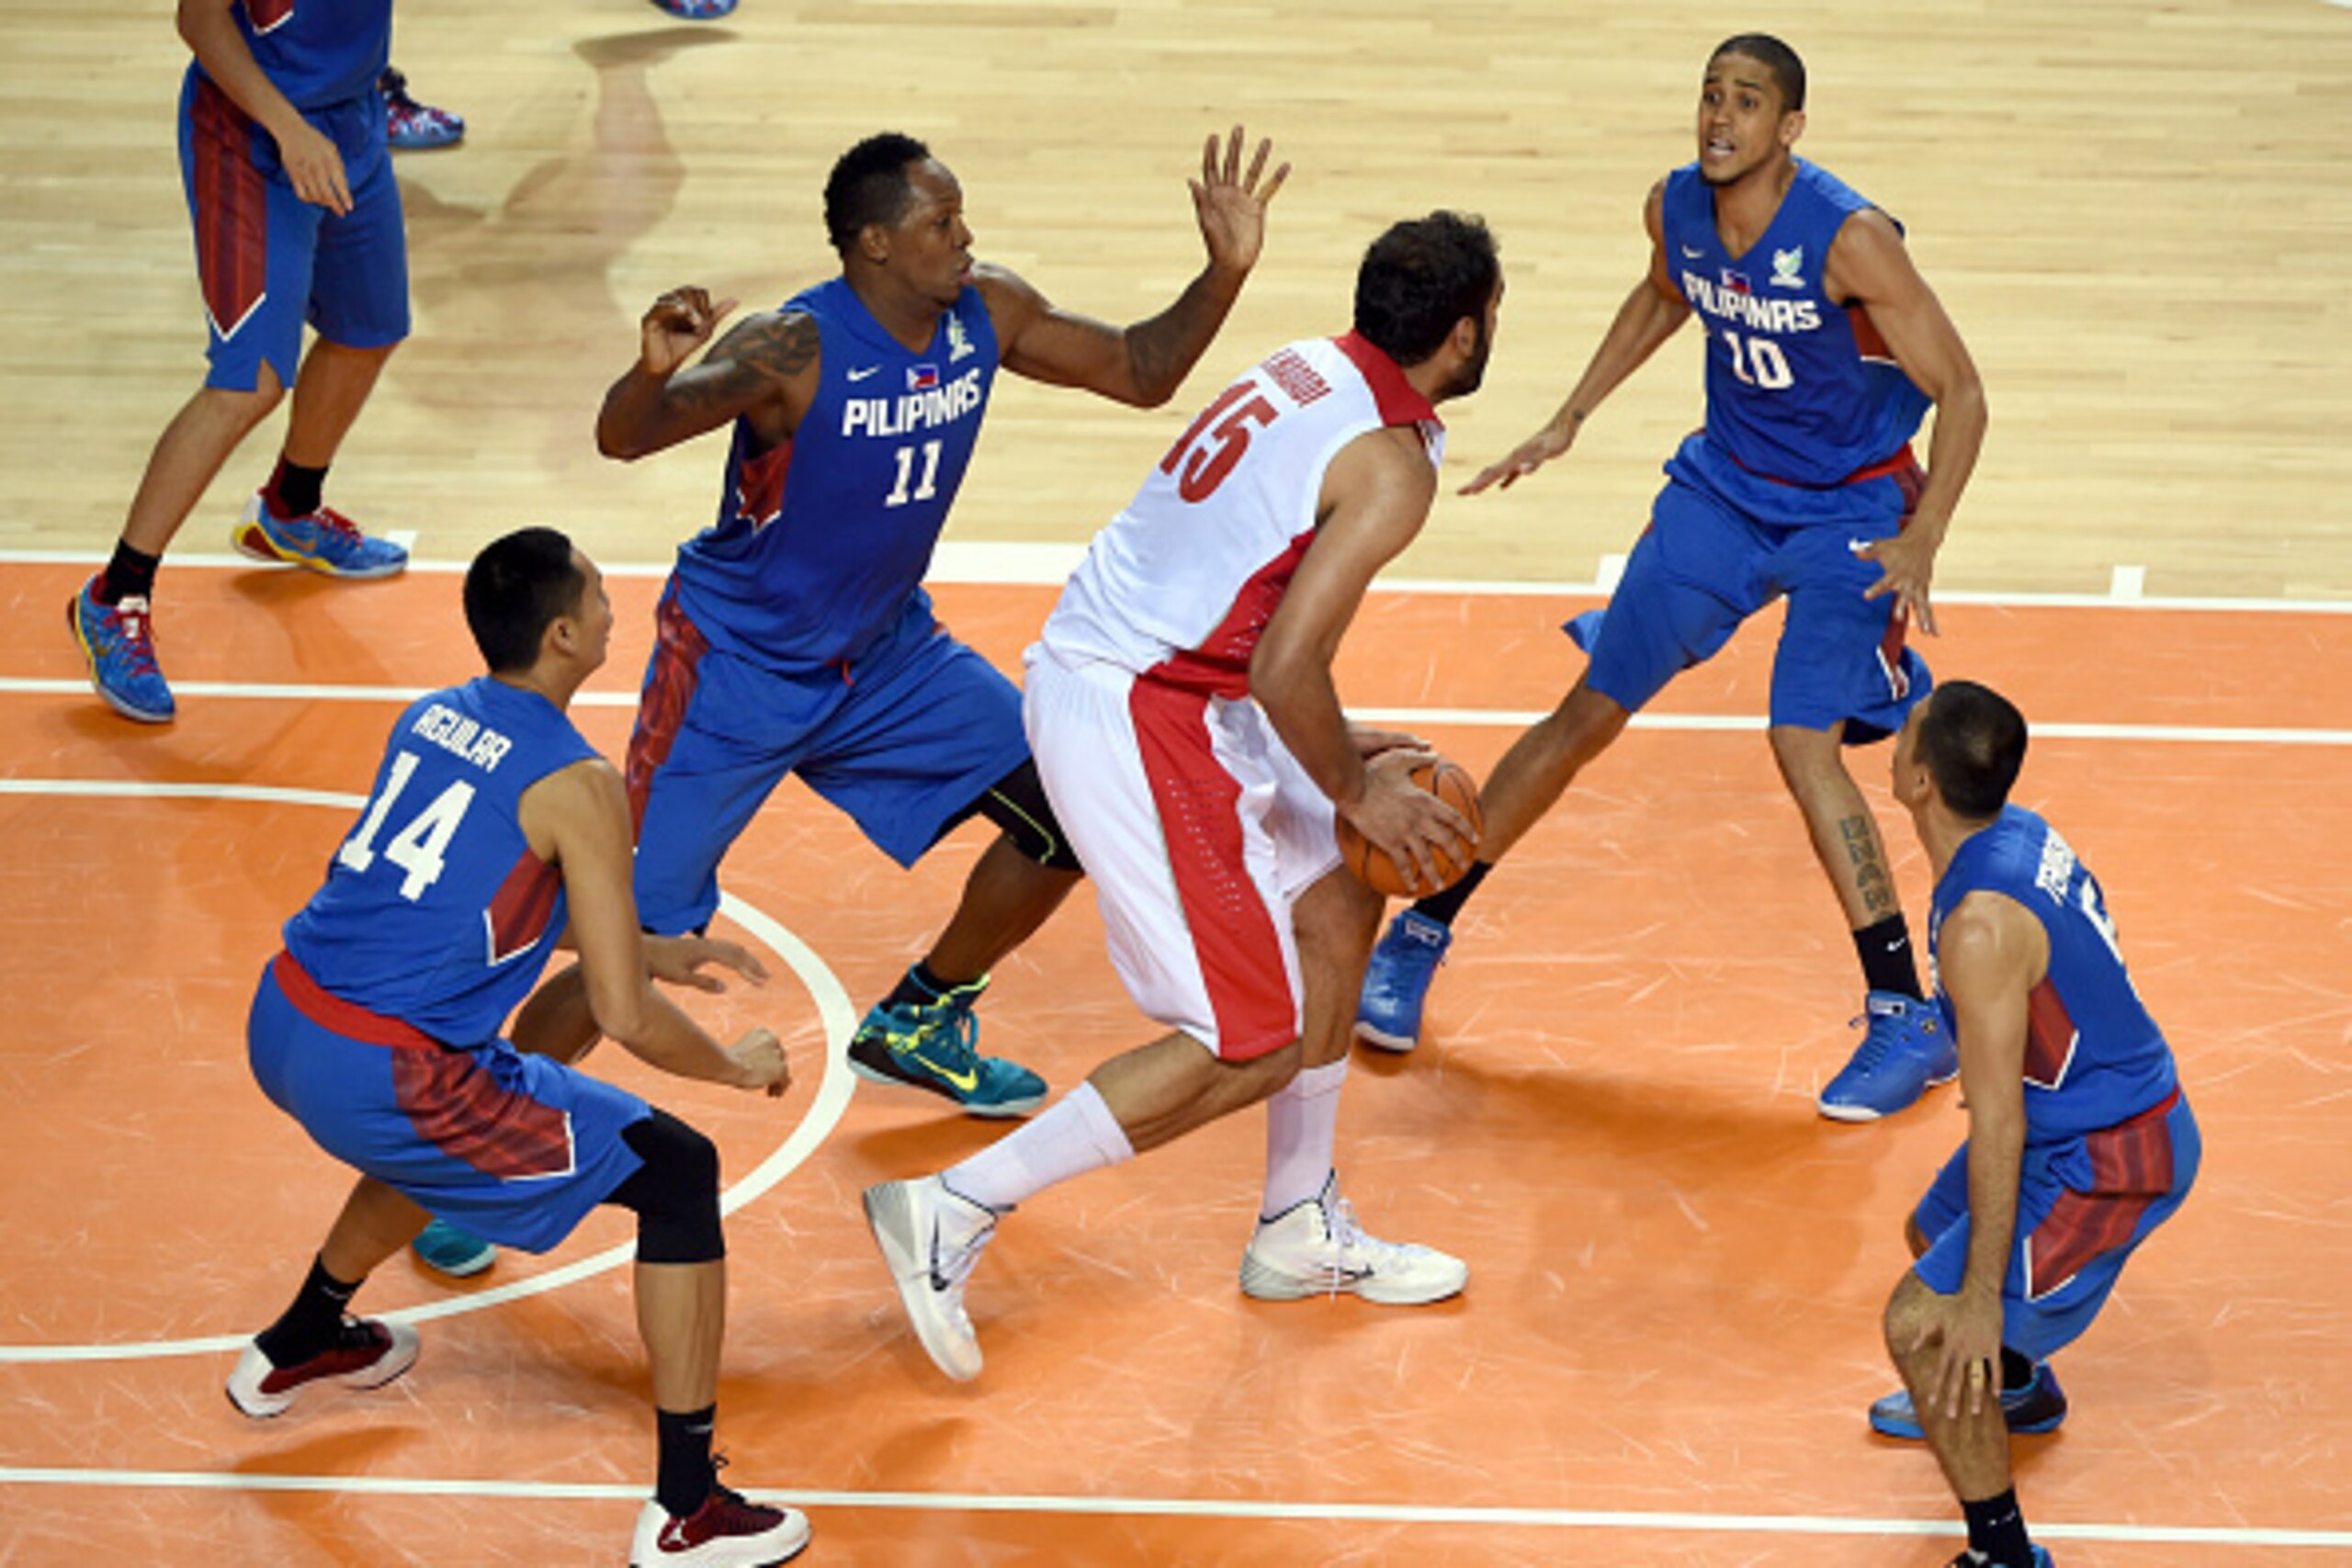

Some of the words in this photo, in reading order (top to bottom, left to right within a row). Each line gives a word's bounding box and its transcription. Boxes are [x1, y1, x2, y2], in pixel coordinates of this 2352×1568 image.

[1682, 270, 1822, 333] PILIPINAS
[1723, 331, 1794, 389] 10
[842, 367, 980, 436] PILIPINAS
[885, 440, 942, 507] 11
[1159, 379, 1280, 503] 15
[339, 750, 476, 902] 14
